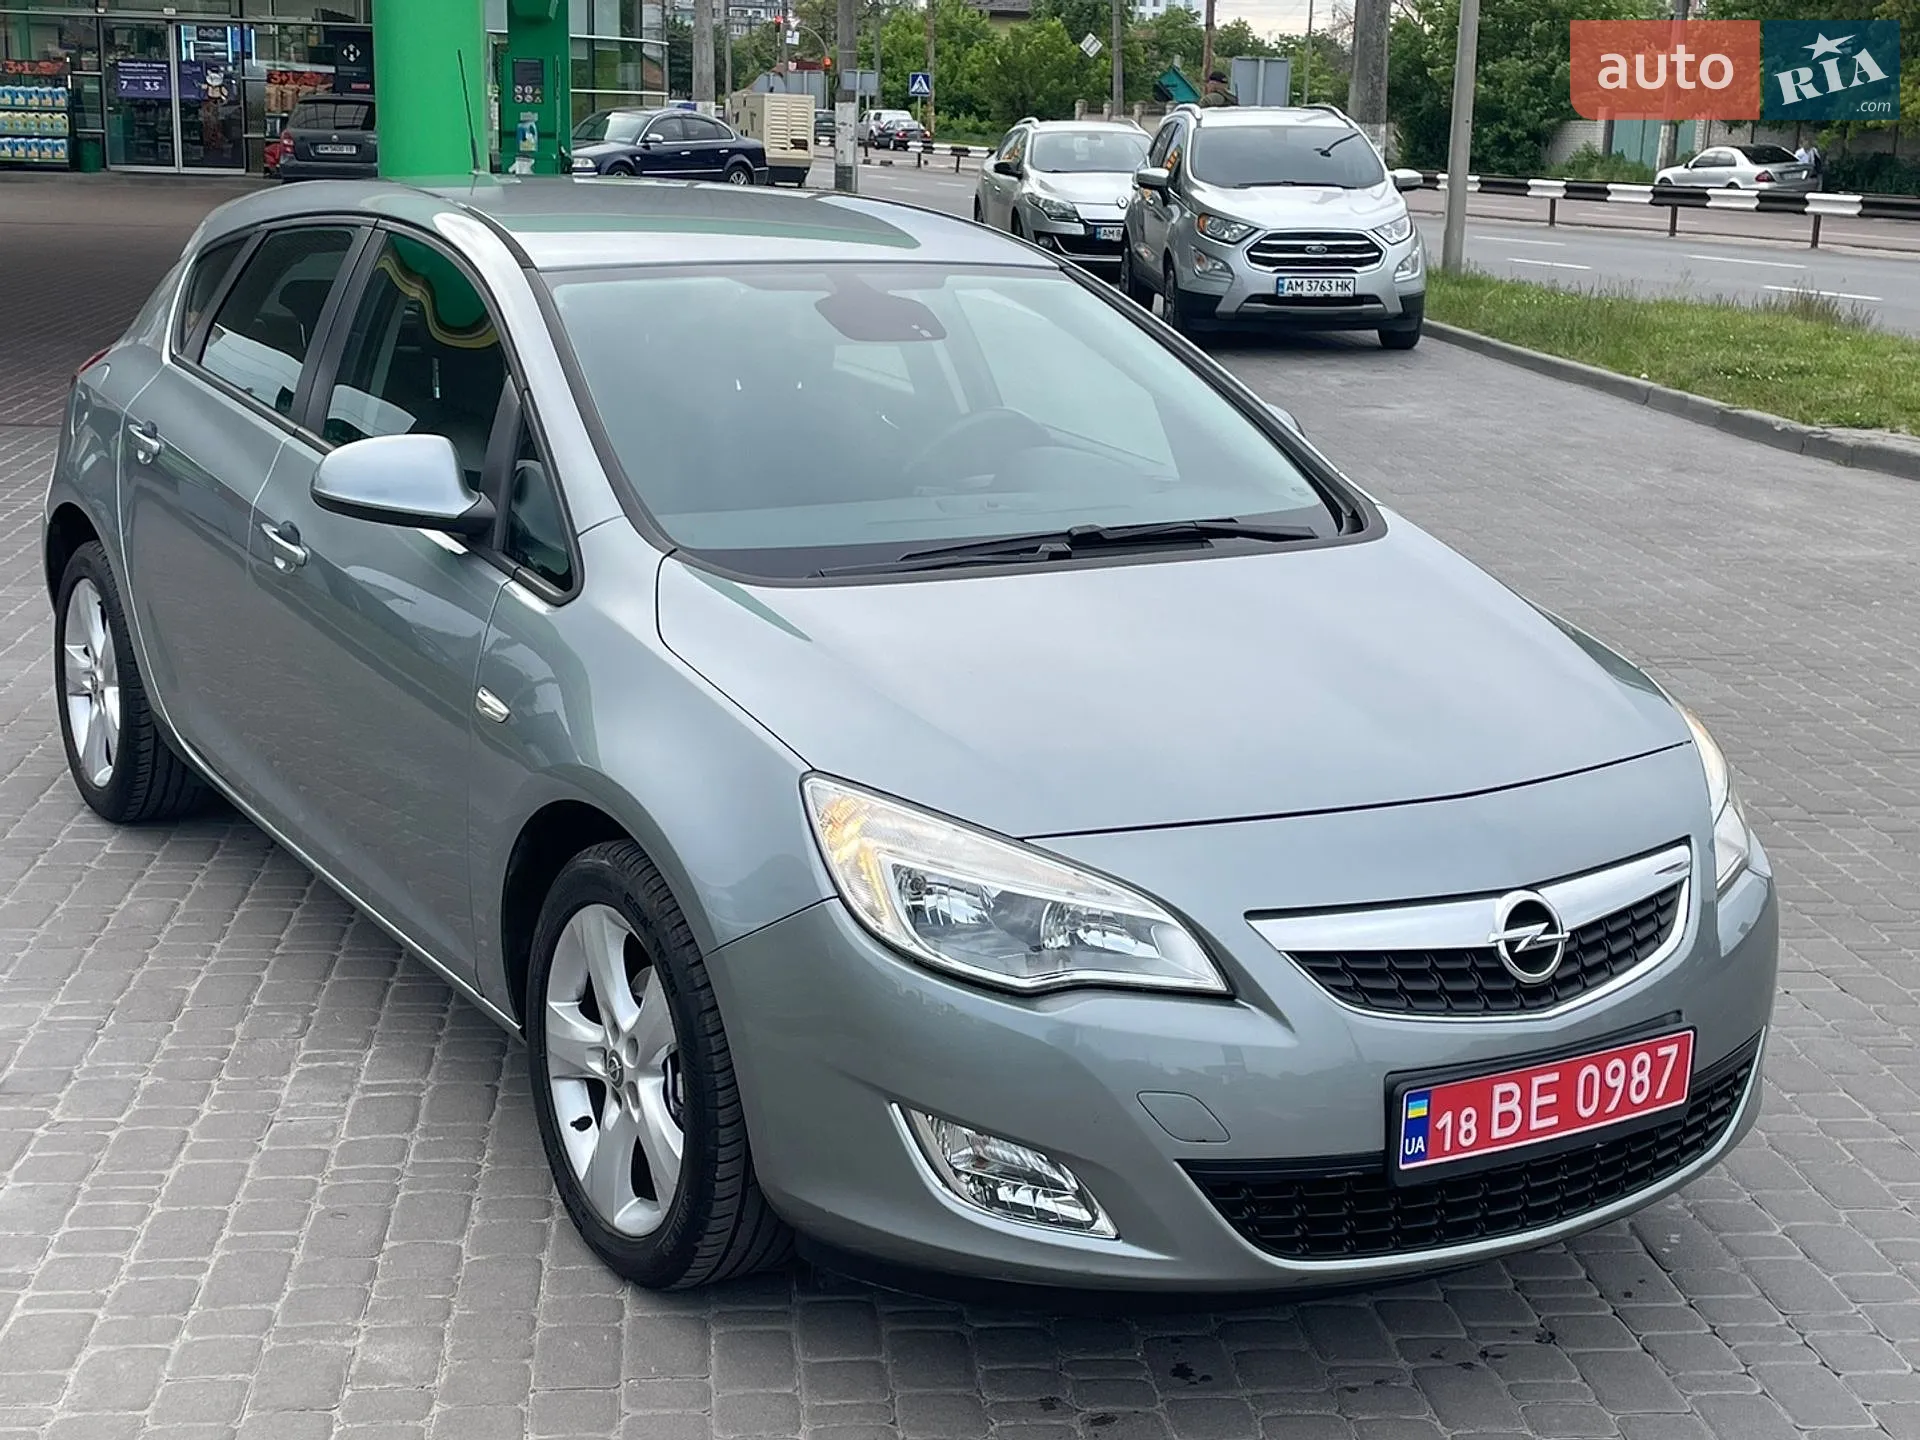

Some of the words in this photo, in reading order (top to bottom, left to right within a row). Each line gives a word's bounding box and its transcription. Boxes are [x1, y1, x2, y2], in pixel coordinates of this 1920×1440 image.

[1286, 280, 1304, 292] AM
[1306, 280, 1333, 292] 3763
[1335, 280, 1352, 292] HK
[1435, 1106, 1478, 1152] 18
[1490, 1071, 1560, 1140] BE
[1576, 1043, 1680, 1119] 0987
[1405, 1135, 1426, 1156] UA
